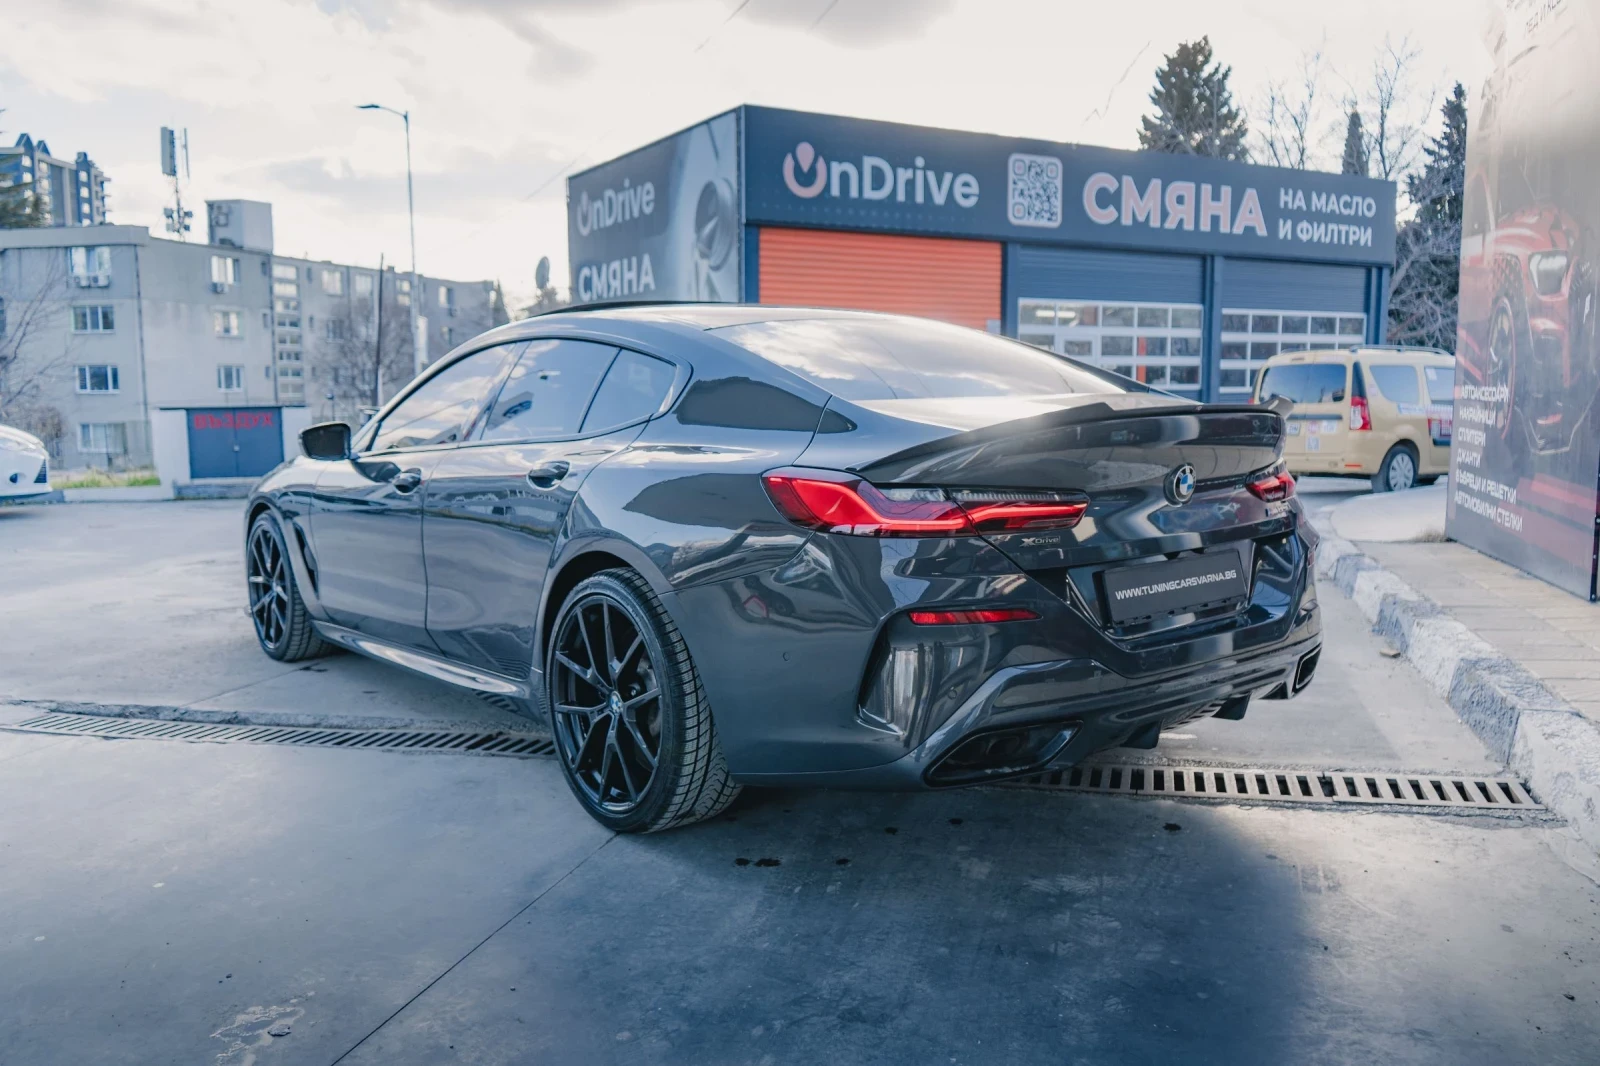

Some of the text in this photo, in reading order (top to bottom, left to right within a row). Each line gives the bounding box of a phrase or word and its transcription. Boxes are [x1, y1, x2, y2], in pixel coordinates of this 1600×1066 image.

[1083, 172, 1268, 237] СМЯНА
[1279, 187, 1377, 218] НА МАСЛО
[1278, 219, 1373, 248] И ФИЛТРИ
[578, 253, 656, 301] СМЯНА
[194, 412, 274, 429] ВЪЗДУХ
[1115, 569, 1237, 600] WWW.TUNINGCARSVARNA.BG
